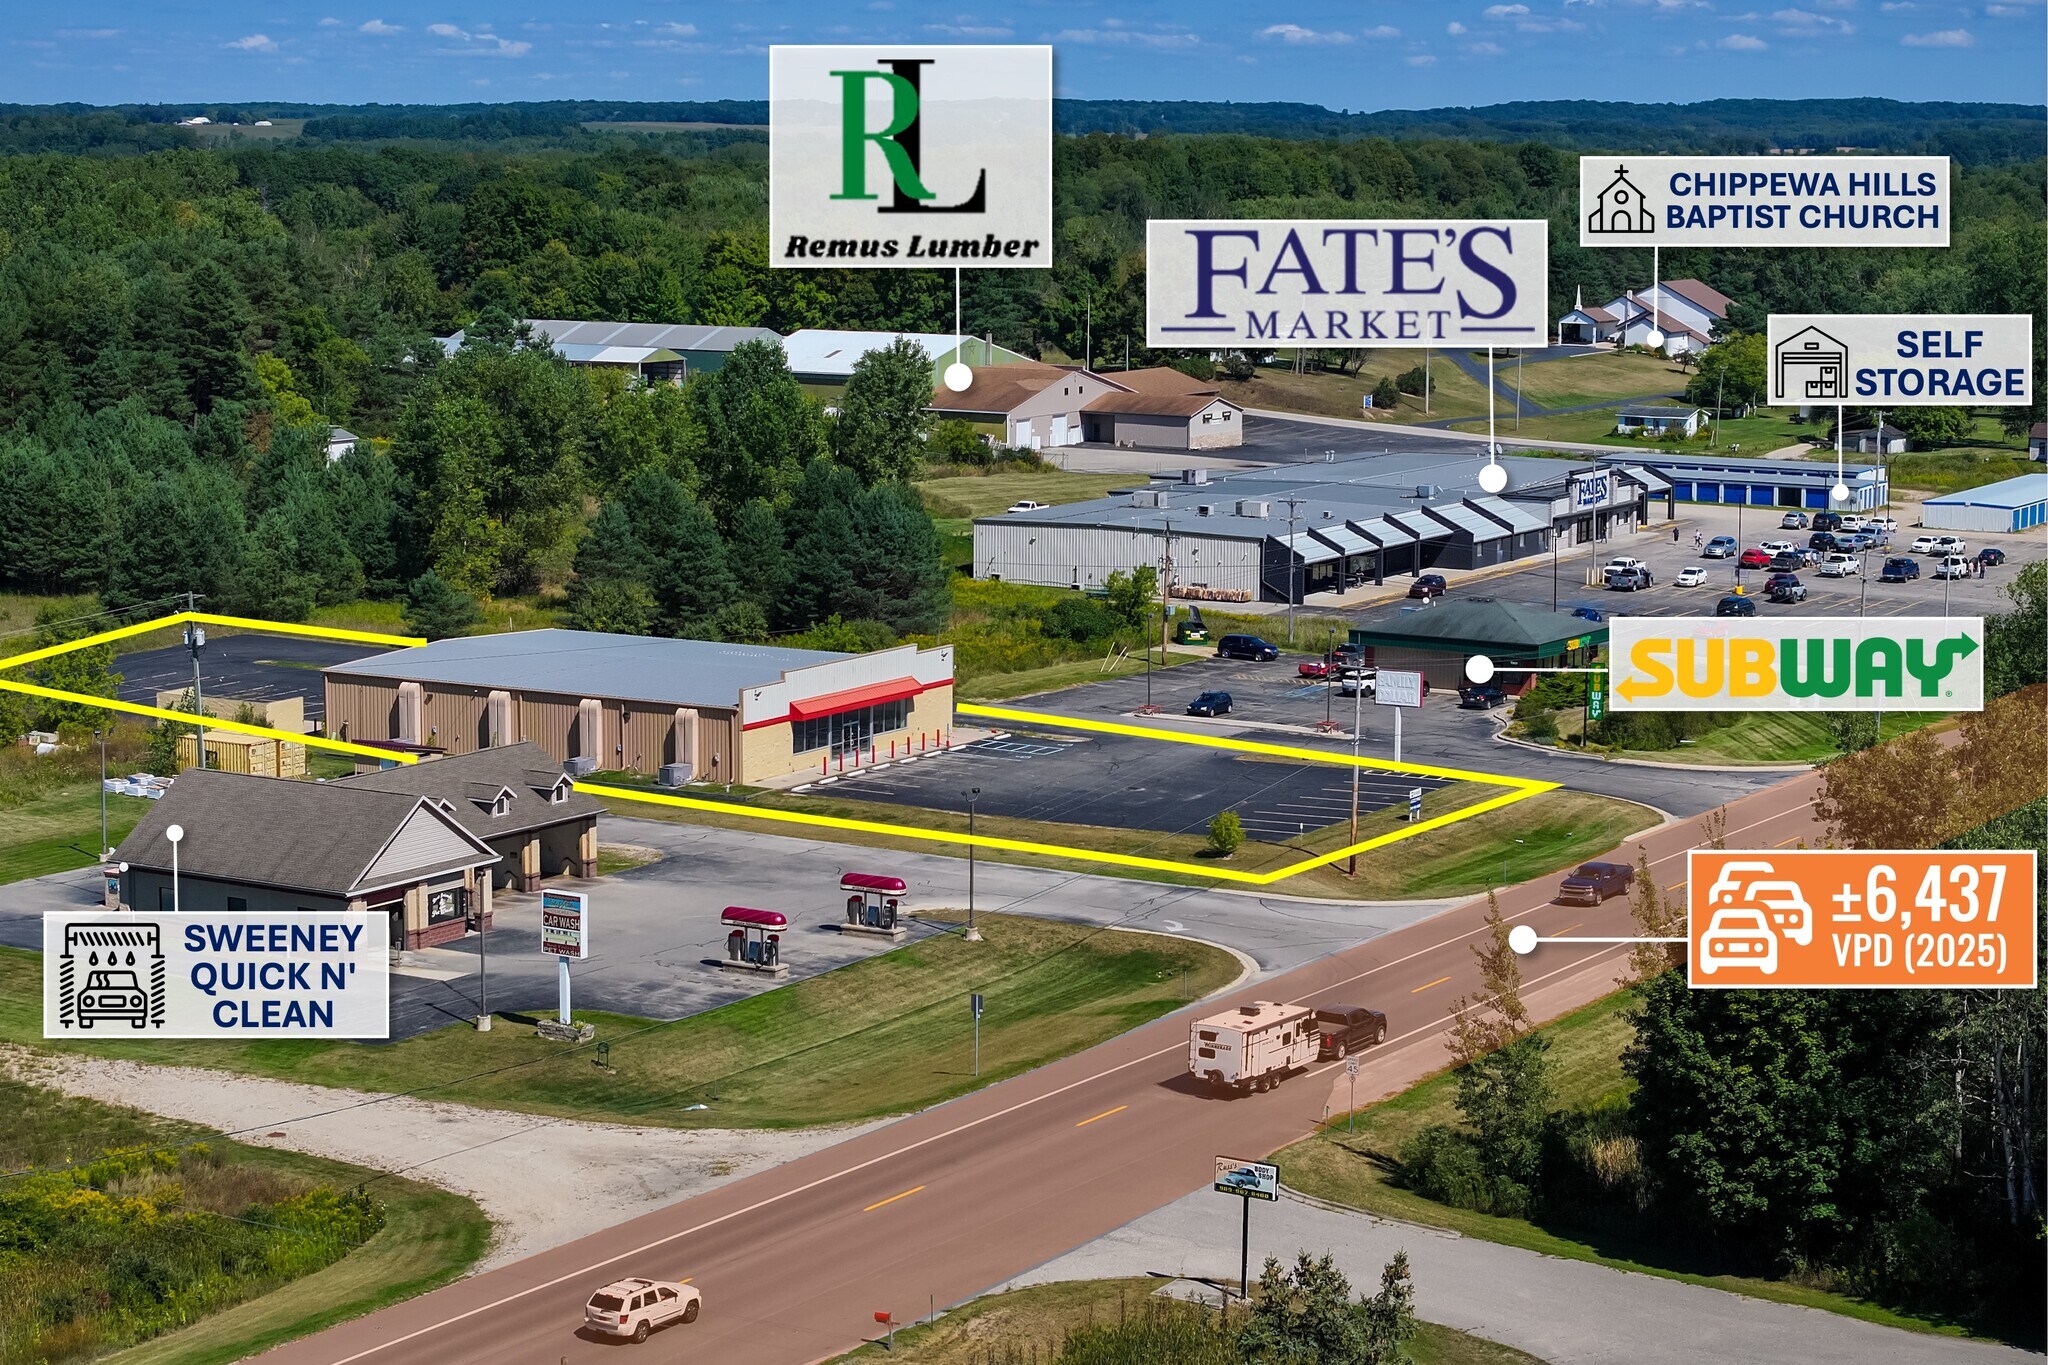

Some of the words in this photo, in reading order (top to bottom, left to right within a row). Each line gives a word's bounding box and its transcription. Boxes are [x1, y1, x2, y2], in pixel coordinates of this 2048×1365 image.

[543, 914, 559, 926] CAR
[559, 917, 580, 930] WASH
[559, 948, 580, 957] WASH
[1347, 1065, 1359, 1074] 45
[1216, 1162, 1238, 1174] Russ's
